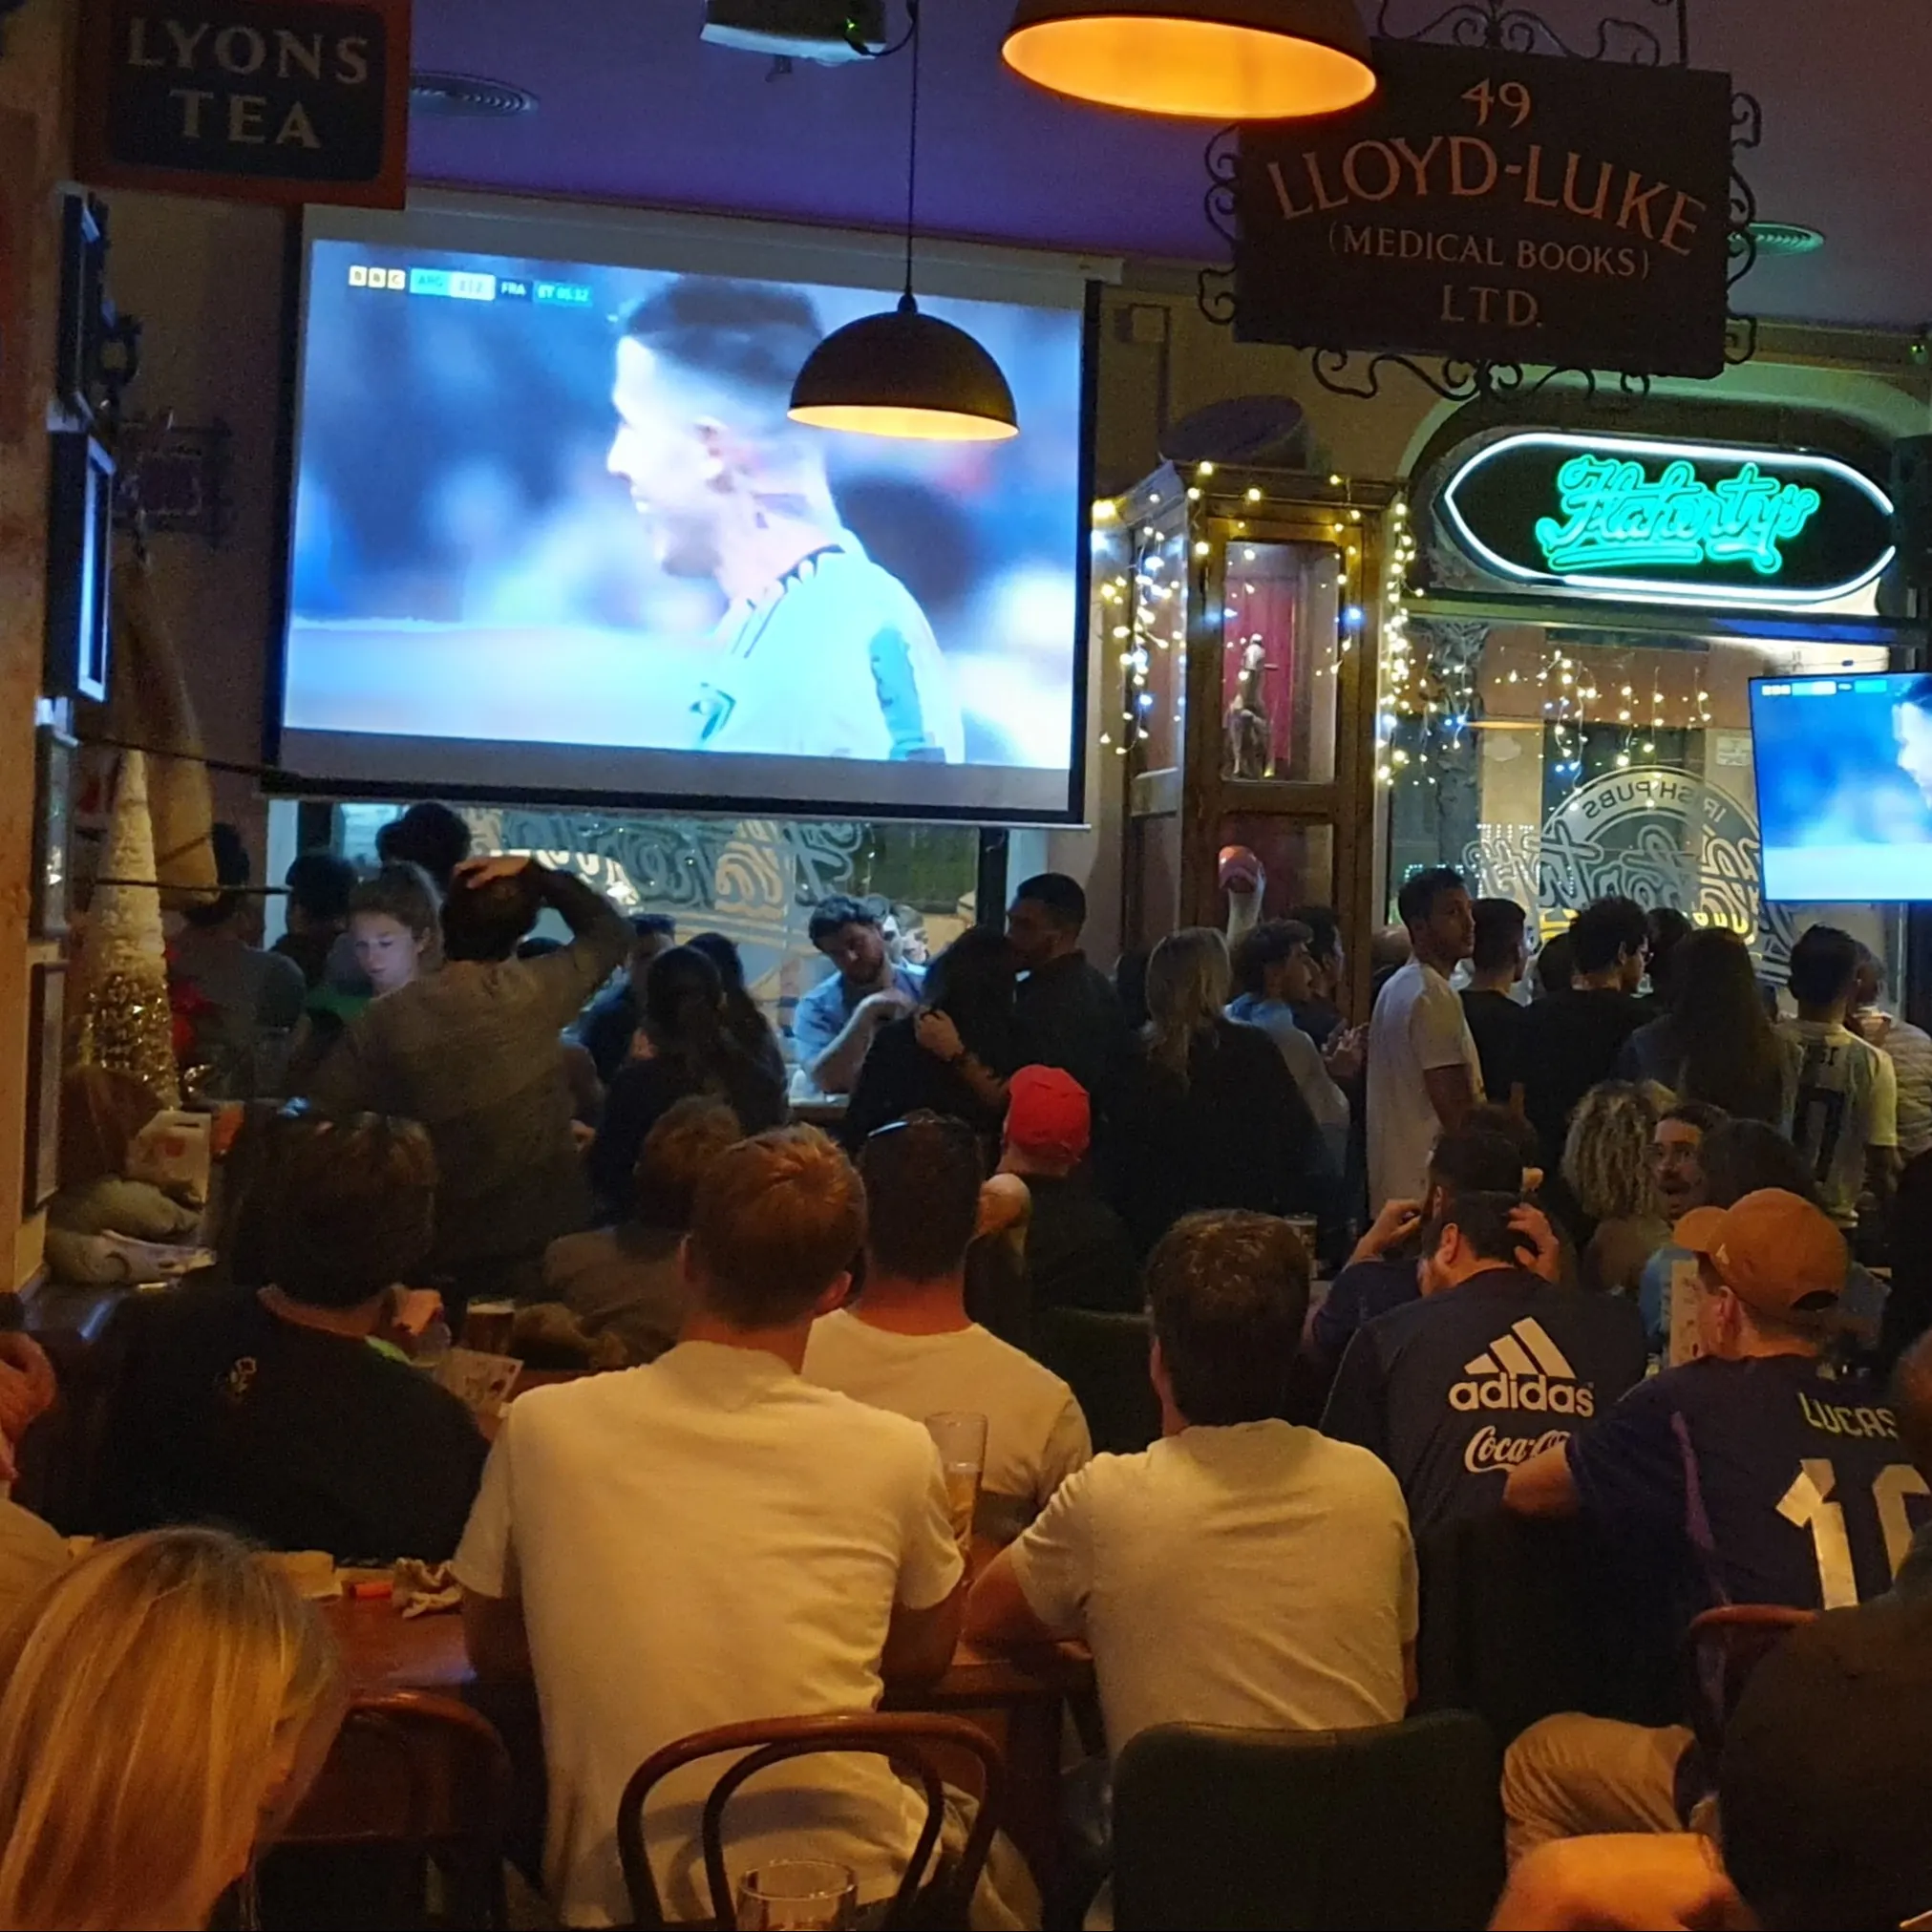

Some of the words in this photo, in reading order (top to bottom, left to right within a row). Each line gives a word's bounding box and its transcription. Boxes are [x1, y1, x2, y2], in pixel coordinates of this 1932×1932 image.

[128, 16, 370, 85] LYONS
[168, 88, 322, 149] TEA
[1461, 77, 1531, 128] 49
[1266, 135, 1708, 257] LLOYD-LUKE
[1328, 220, 1504, 267] (MEDICAL
[1517, 239, 1650, 281] BOOKS)
[500, 282, 526, 296] FRA
[1439, 284, 1543, 329] LTD.
[1449, 1372, 1595, 1418] adidas
[1797, 1391, 1899, 1440] LUCAS
